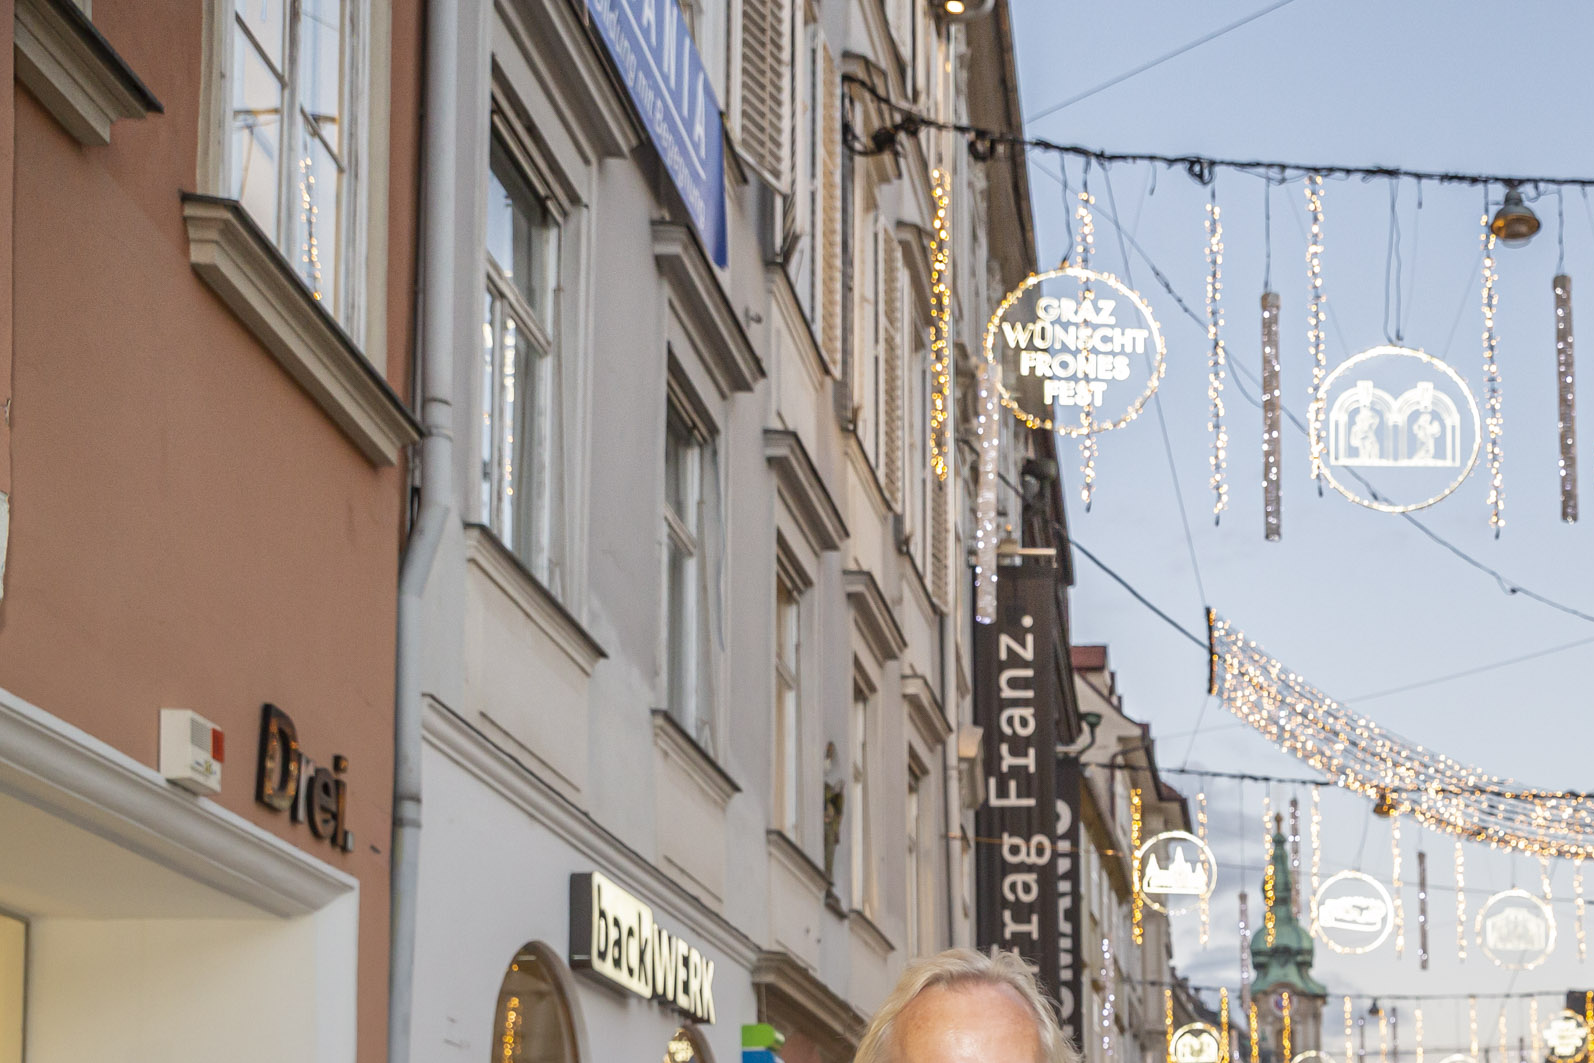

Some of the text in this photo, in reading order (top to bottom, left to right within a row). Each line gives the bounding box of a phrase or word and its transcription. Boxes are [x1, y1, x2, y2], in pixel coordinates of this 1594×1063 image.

[1036, 297, 1116, 325] GRAZ
[1001, 318, 1149, 354] WÜNSCHT
[1043, 379, 1108, 407] FEST
[255, 703, 354, 852] Drei.
[988, 613, 1052, 975] rag Franz.
